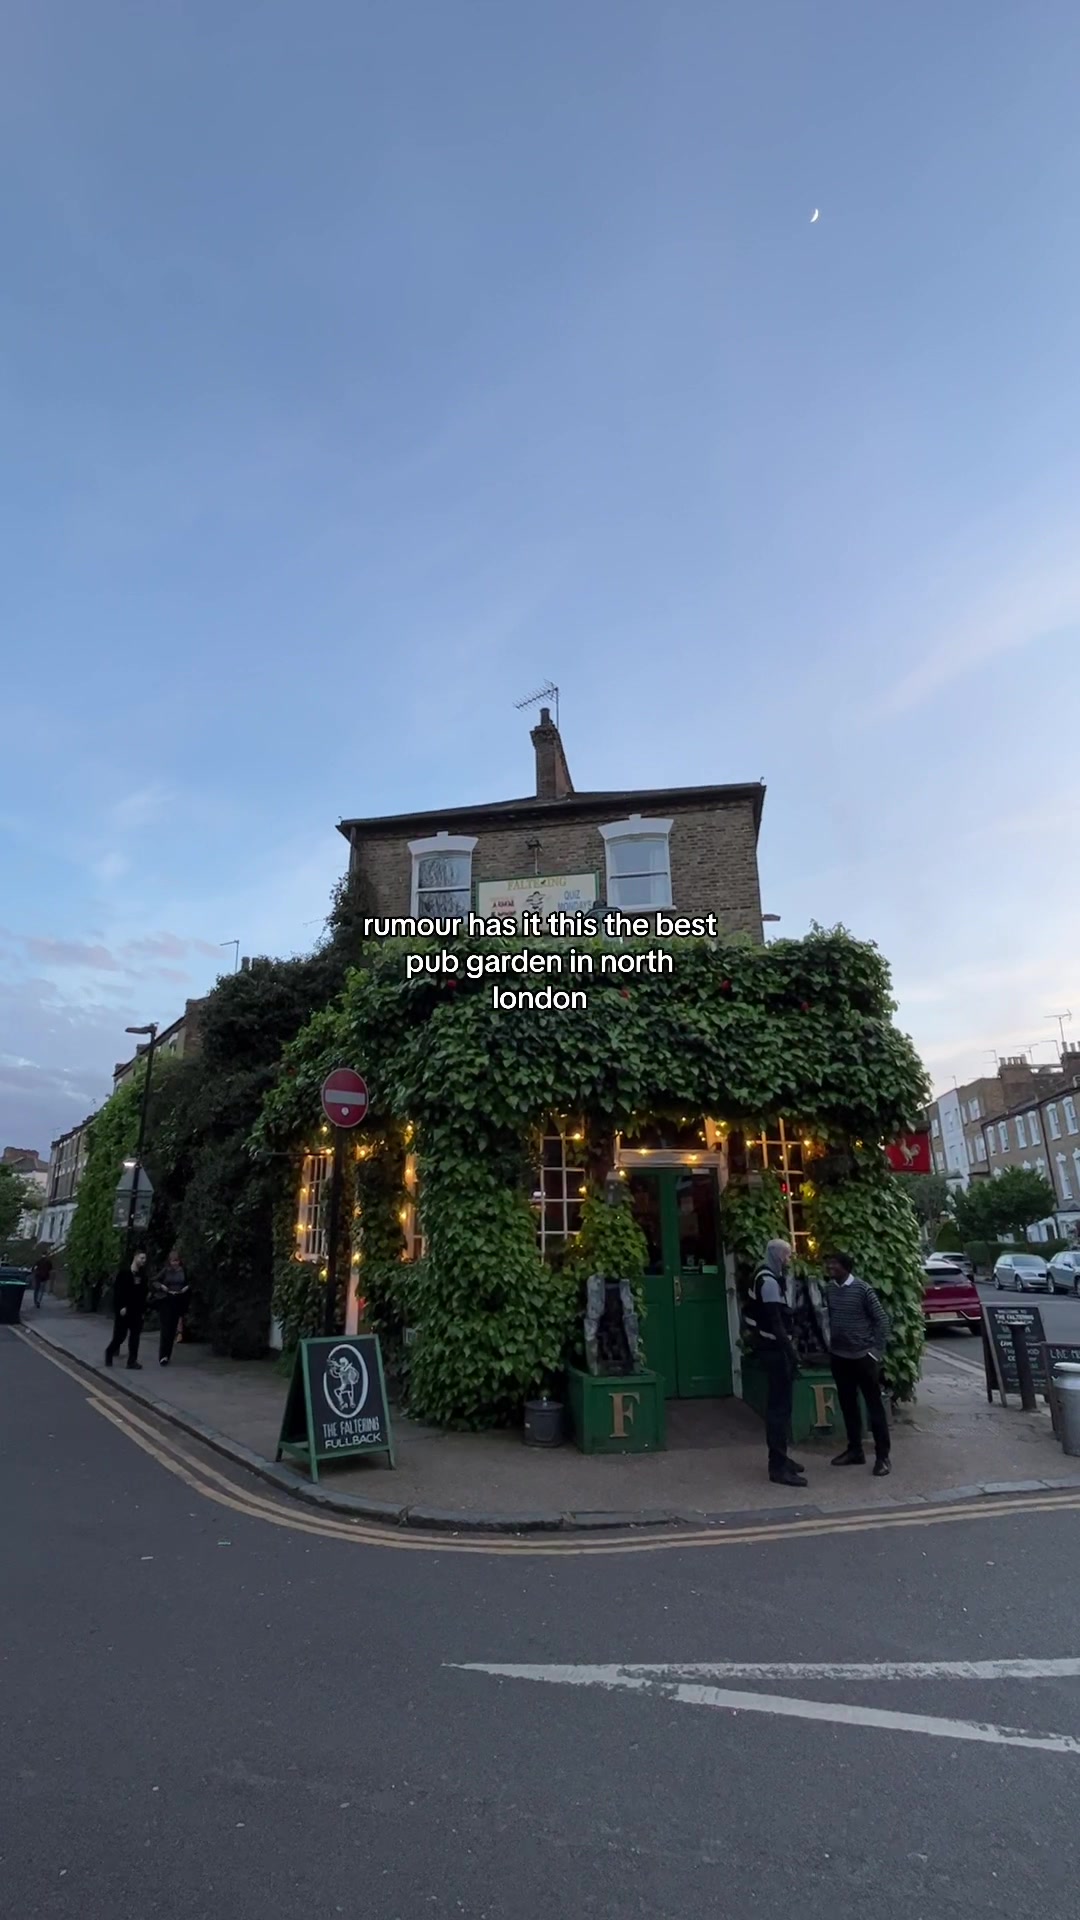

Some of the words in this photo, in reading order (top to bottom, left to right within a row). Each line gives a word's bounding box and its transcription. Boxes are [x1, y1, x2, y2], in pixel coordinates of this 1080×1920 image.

[563, 889, 581, 900] QUIZ
[608, 1392, 640, 1438] F
[810, 1384, 838, 1428] F
[322, 1422, 337, 1439] THE
[339, 1415, 380, 1436] FALTERING
[324, 1432, 382, 1449] FULLBACK
